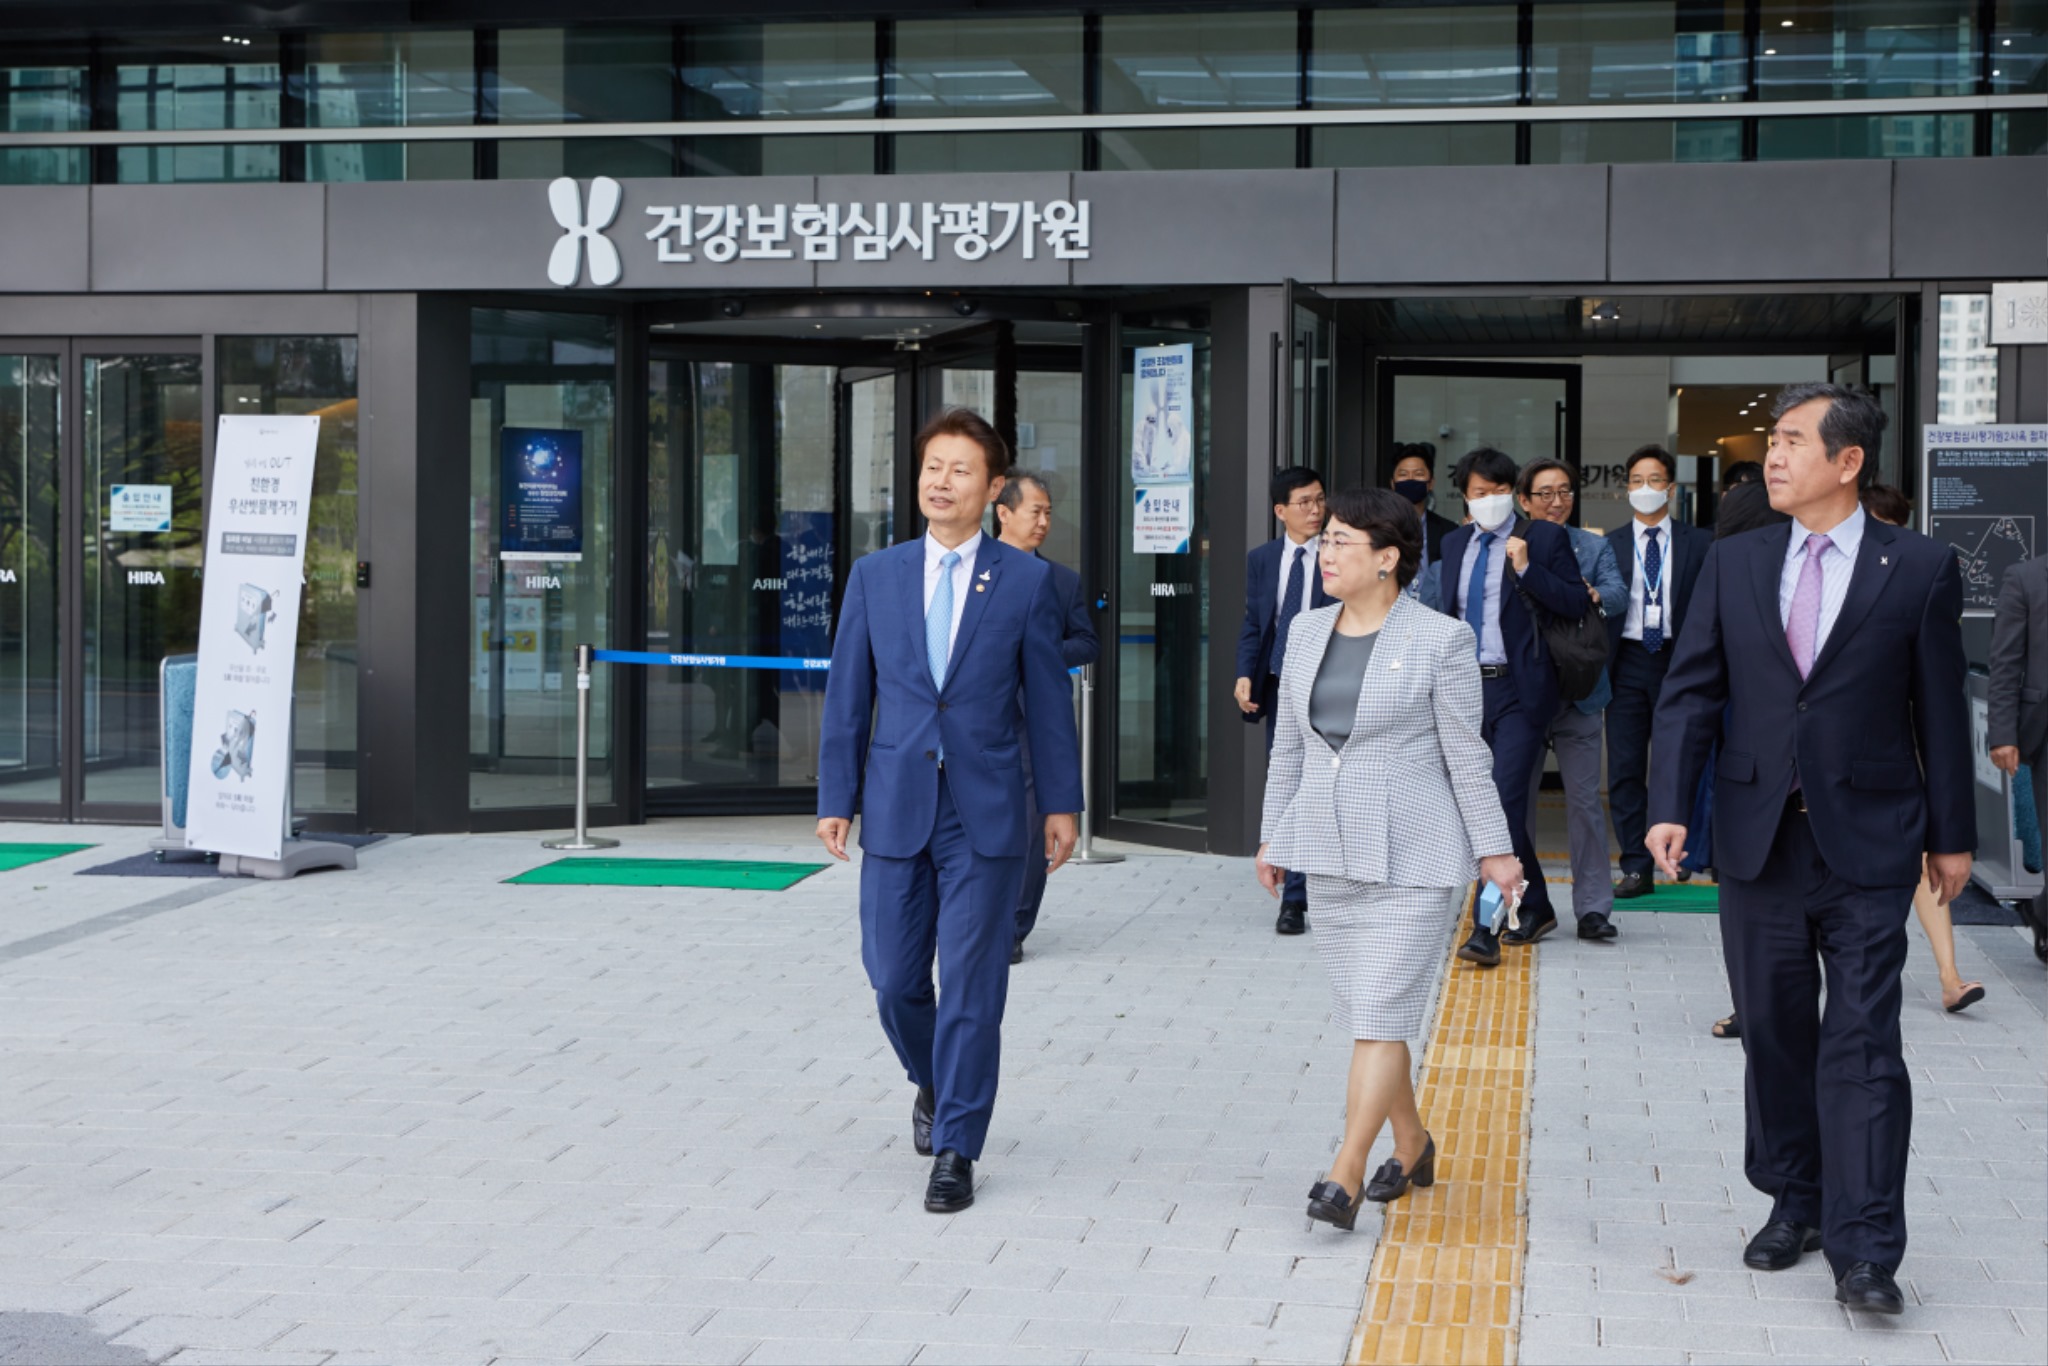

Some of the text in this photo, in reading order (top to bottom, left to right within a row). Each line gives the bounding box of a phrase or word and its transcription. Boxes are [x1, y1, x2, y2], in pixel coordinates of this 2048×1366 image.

[644, 200, 1091, 262] 건강보험심사평가원
[251, 477, 280, 494] 친환경
[228, 498, 298, 516] 우산빗물제거기
[127, 571, 166, 584] HIRA
[525, 576, 562, 589] HIRA
[1151, 583, 1176, 596] HIRA
